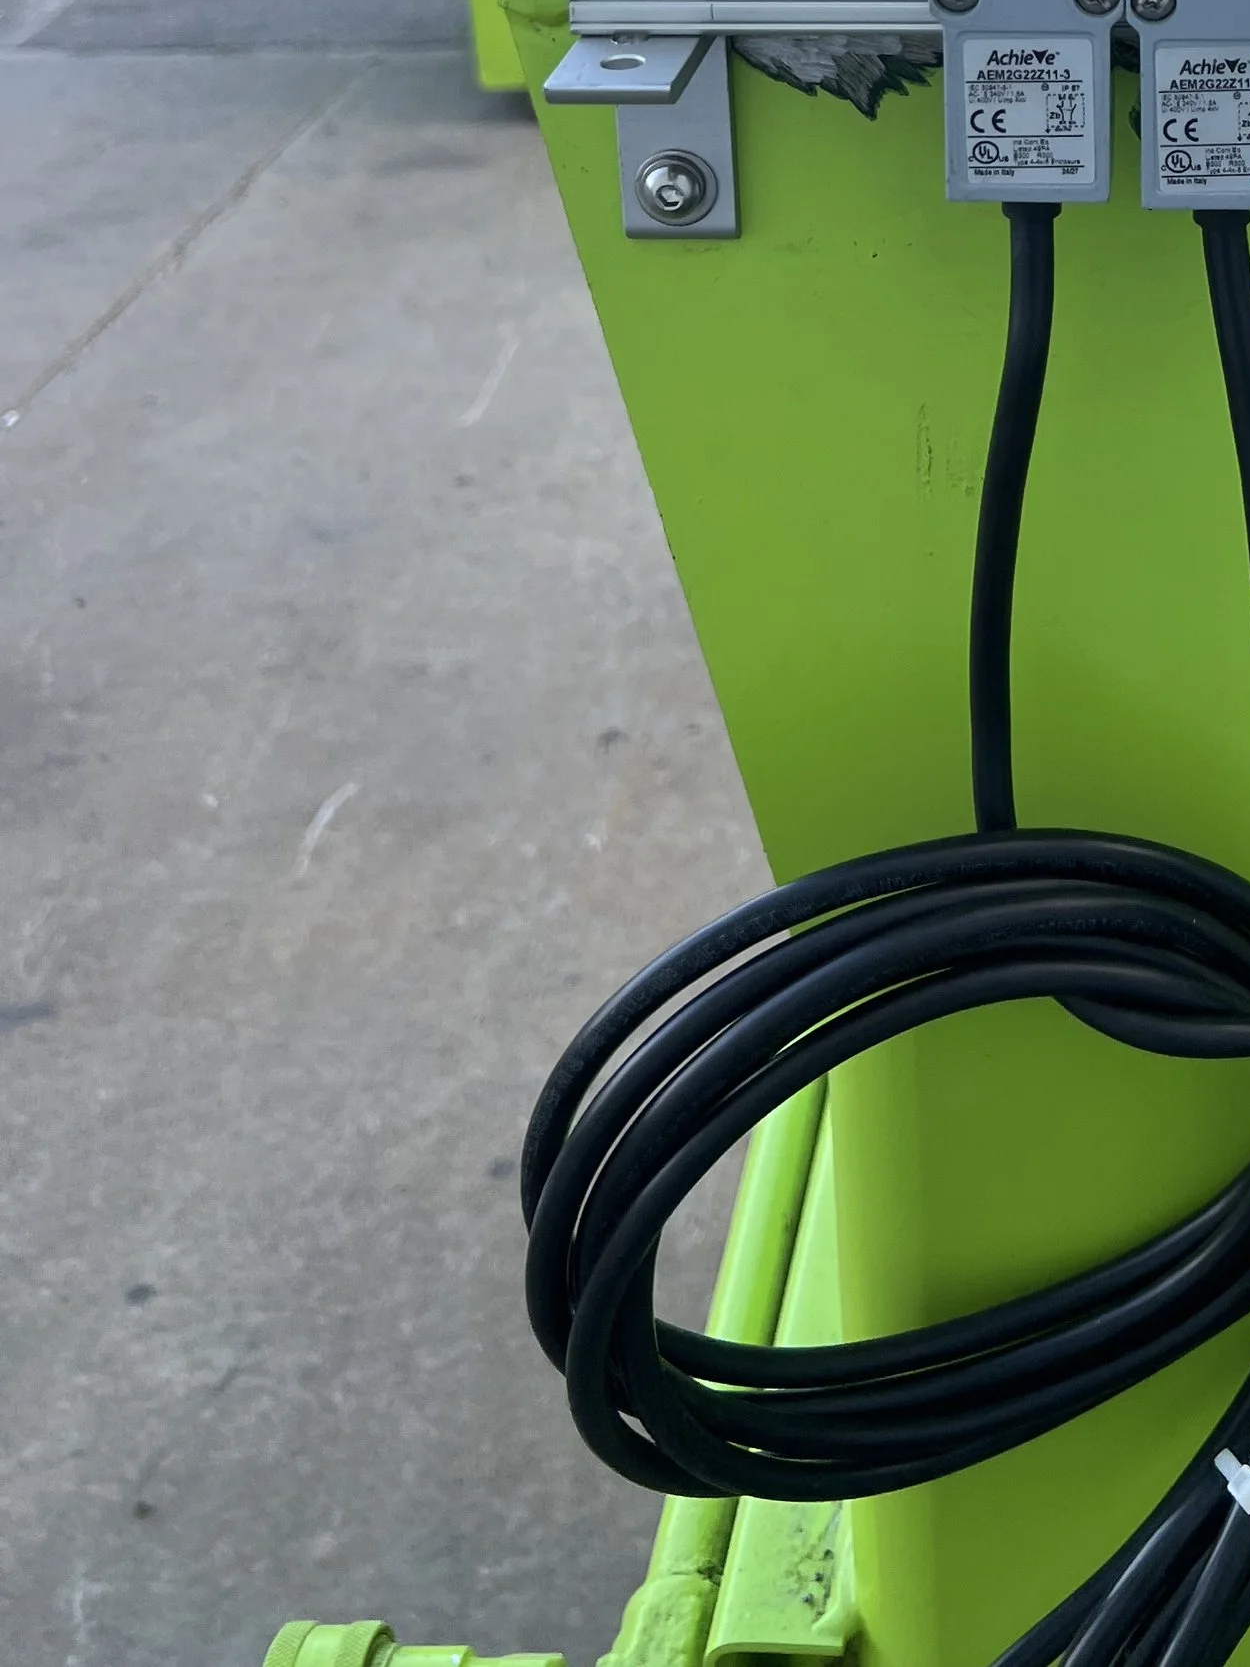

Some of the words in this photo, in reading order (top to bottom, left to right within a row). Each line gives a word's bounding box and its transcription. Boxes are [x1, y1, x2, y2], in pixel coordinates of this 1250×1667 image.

[977, 68, 1072, 81] AEM2G22Z11-3
[1001, 168, 1016, 178] Italy
[1167, 177, 1185, 185] Made
[1193, 177, 1208, 186] Italy
